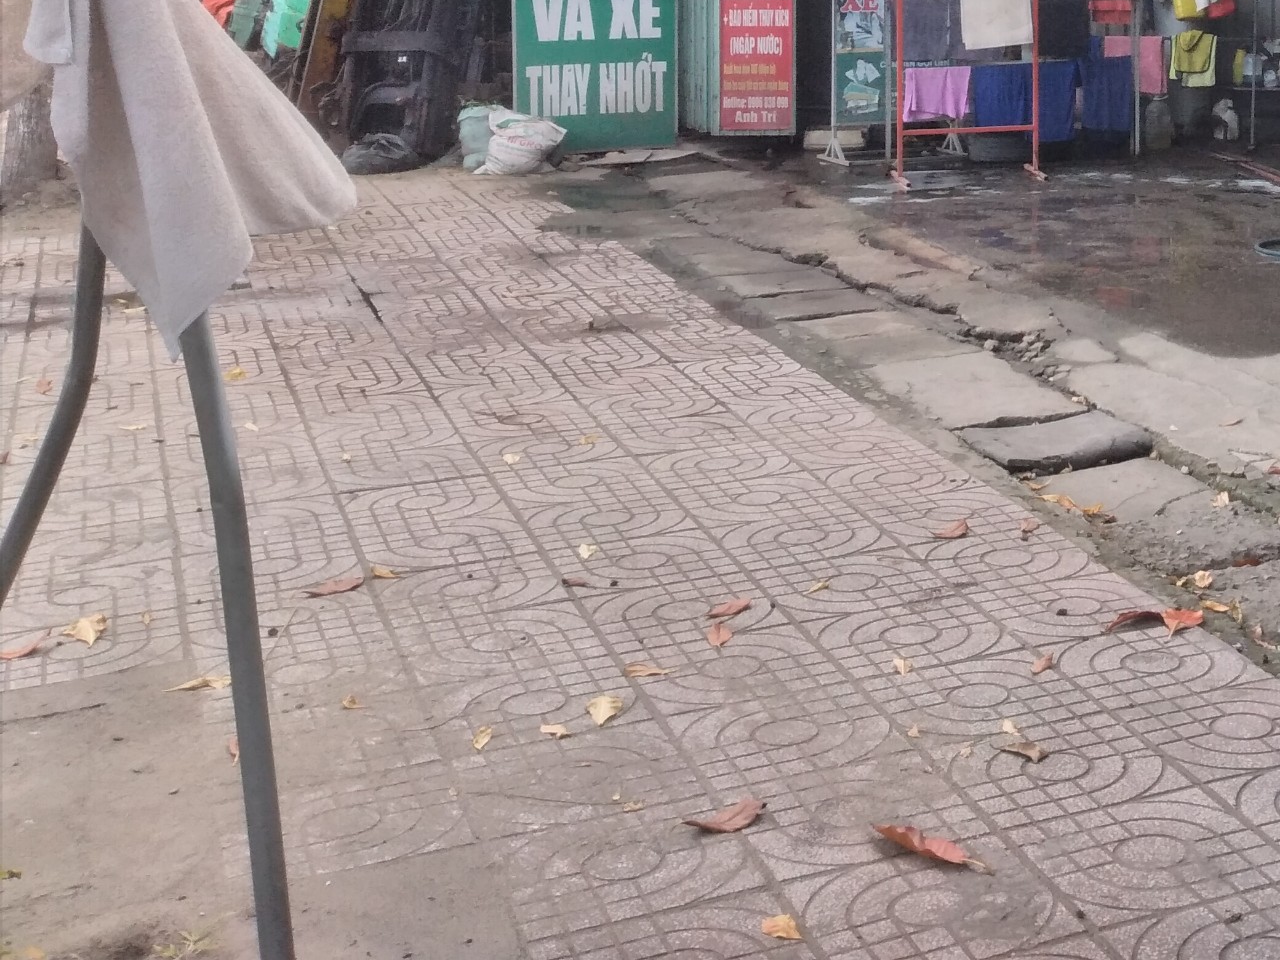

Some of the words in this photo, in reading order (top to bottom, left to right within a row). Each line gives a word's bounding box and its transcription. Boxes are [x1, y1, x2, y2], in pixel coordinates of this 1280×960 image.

[525, 62, 591, 117] THAY
[600, 52, 667, 115] NHỚT
[735, 111, 758, 123] Anh
